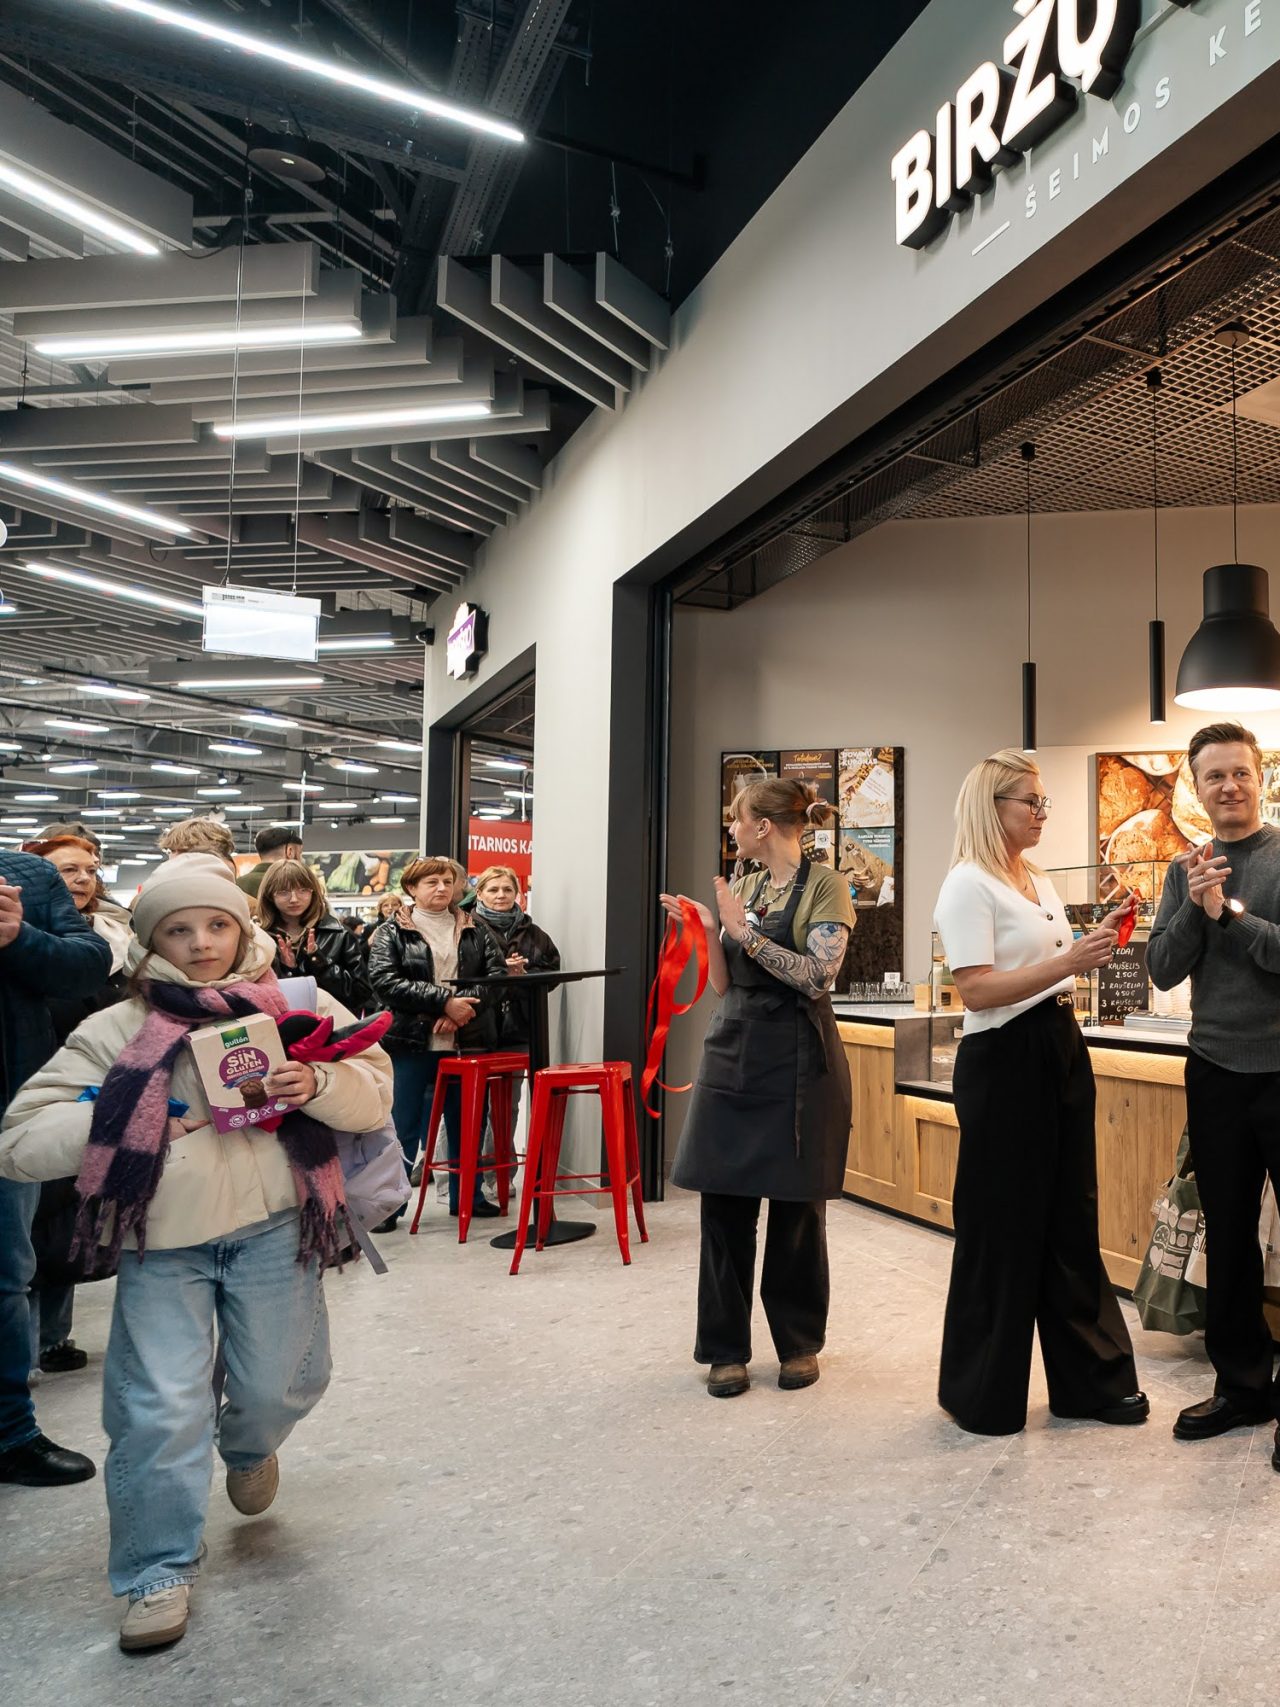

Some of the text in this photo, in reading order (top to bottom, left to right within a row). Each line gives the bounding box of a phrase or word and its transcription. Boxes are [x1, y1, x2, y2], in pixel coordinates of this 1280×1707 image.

[891, 0, 1117, 245] BIRŽŲ
[1025, 77, 1171, 219] ŠEIMOS
[1107, 961, 1141, 971] KAUŠELIS
[1109, 981, 1144, 990] KAUŠELIAI
[224, 1036, 249, 1048] gullón
